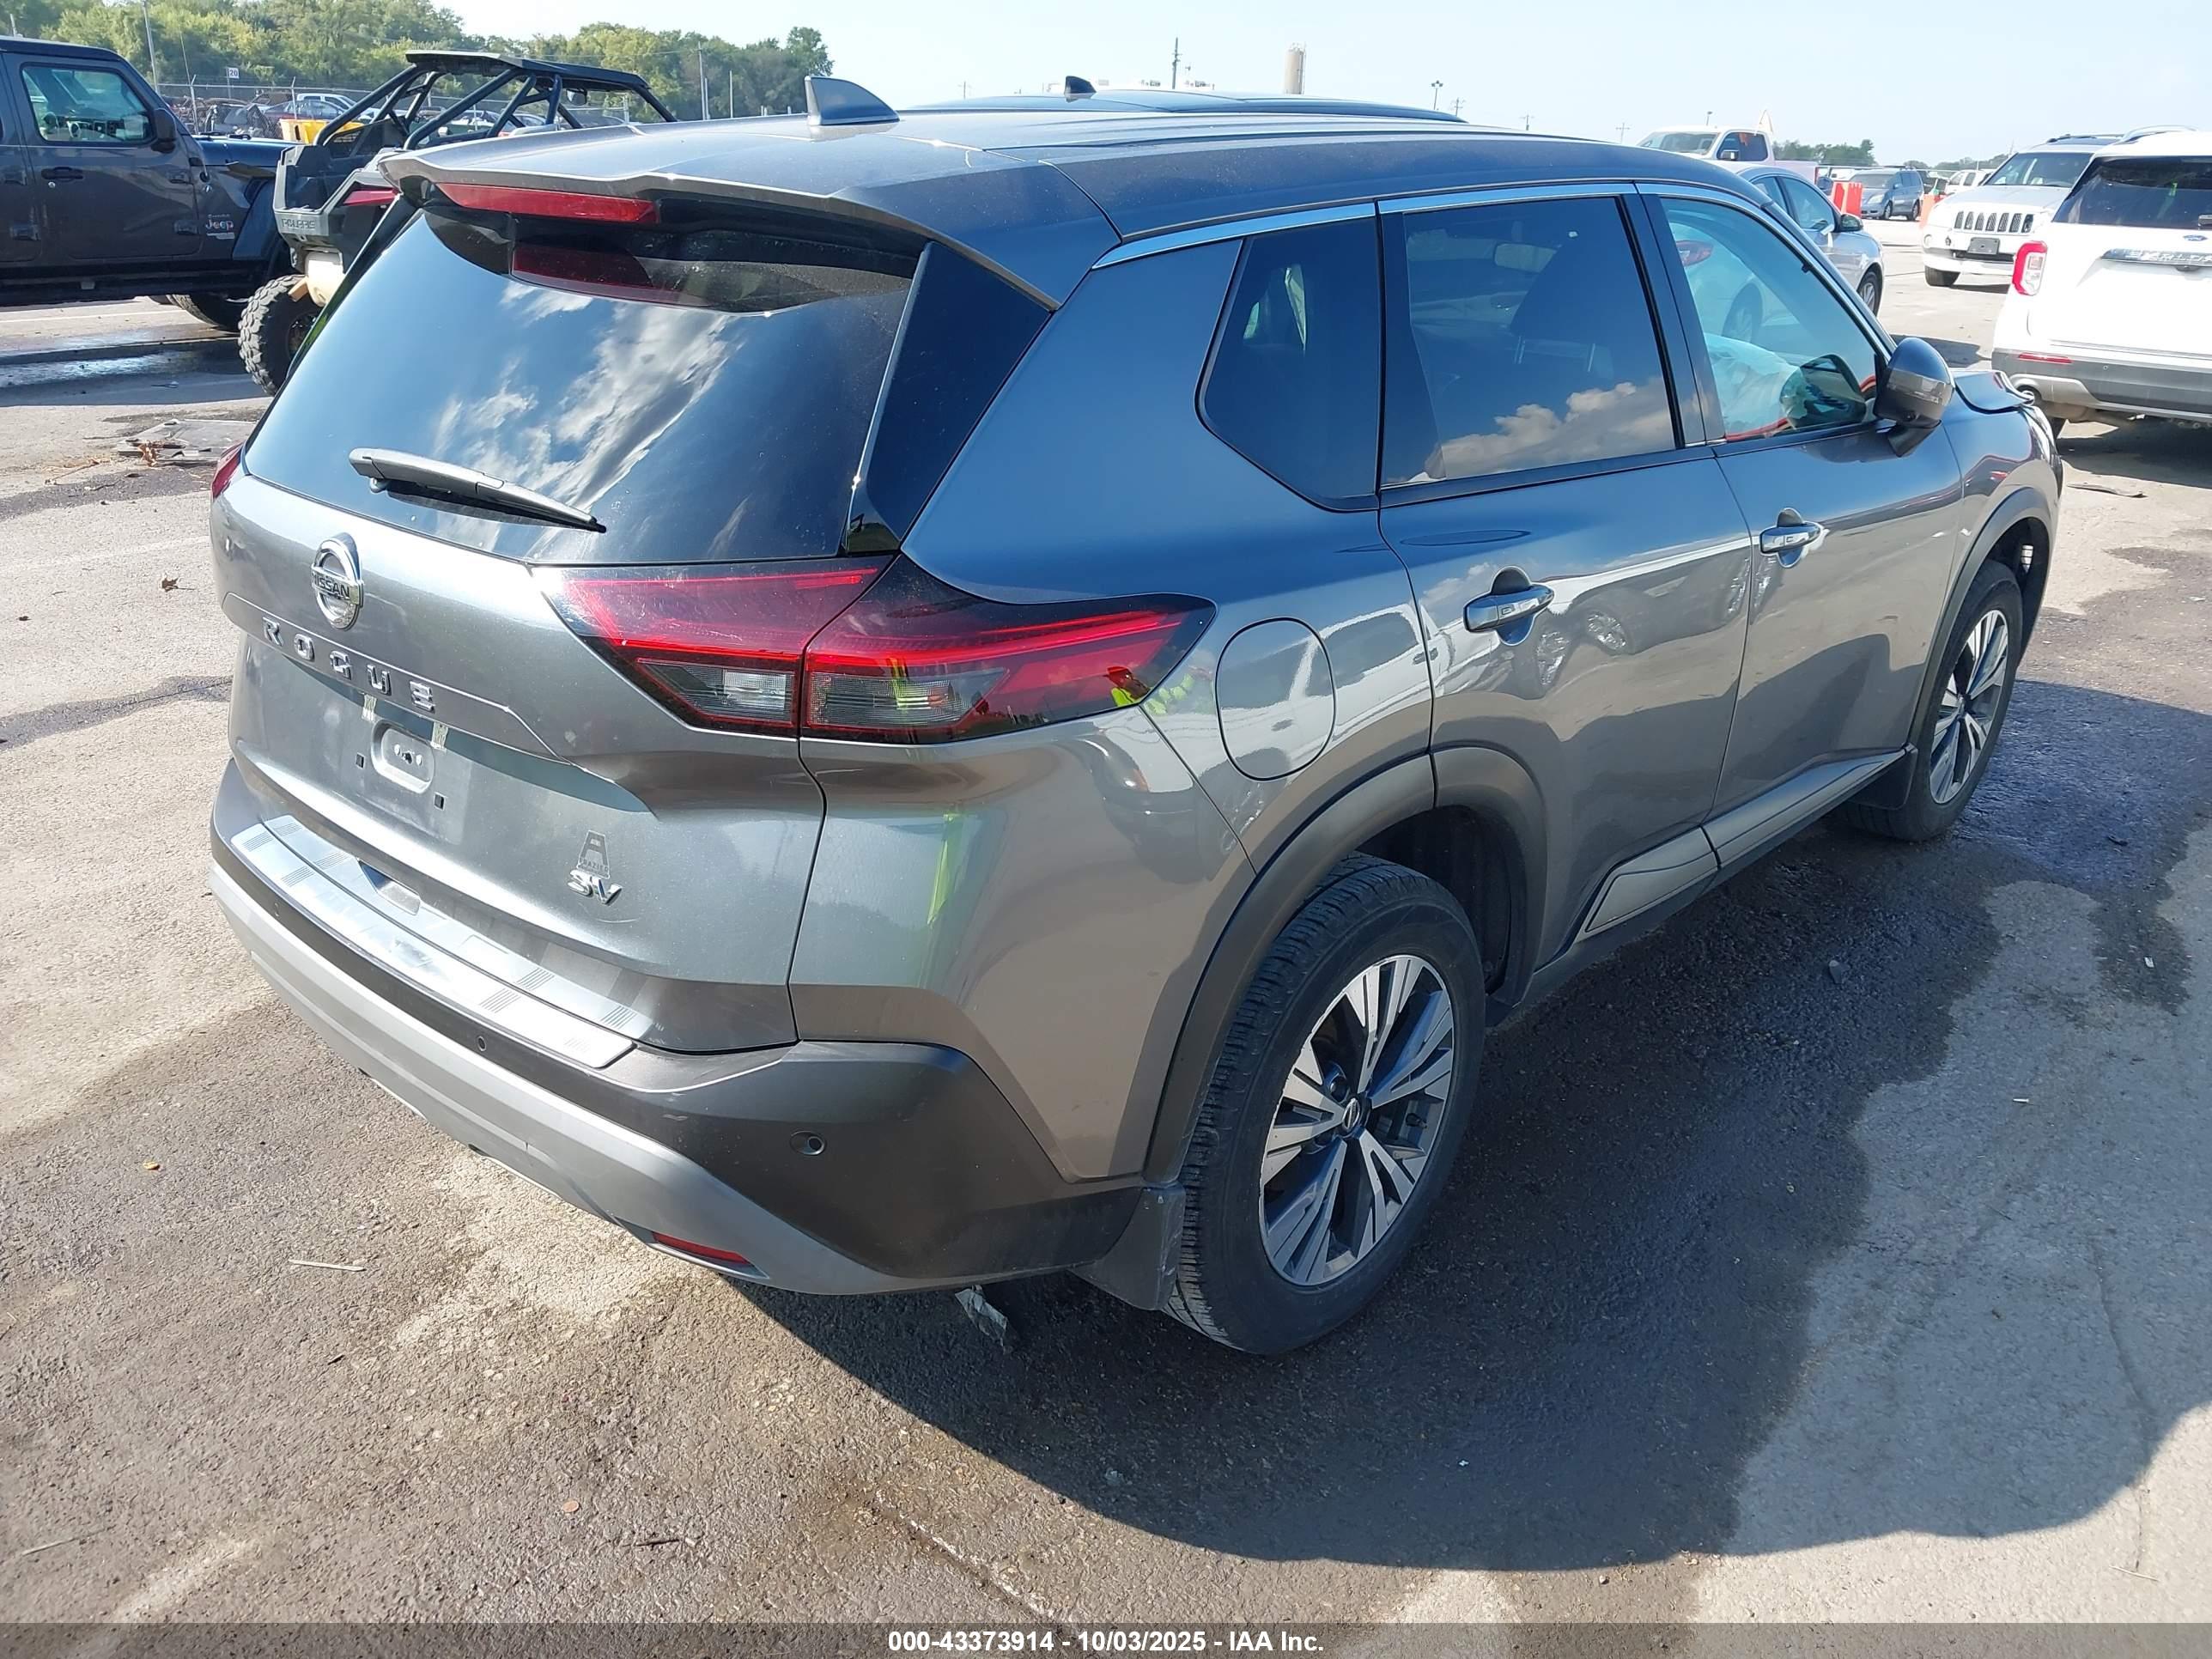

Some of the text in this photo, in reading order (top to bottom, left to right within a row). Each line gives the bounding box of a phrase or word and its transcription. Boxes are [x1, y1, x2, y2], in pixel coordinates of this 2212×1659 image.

[206, 220, 234, 231] Jeep
[312, 570, 349, 599] NISSAN
[262, 617, 435, 714] ROGUE
[568, 870, 623, 906] SV
